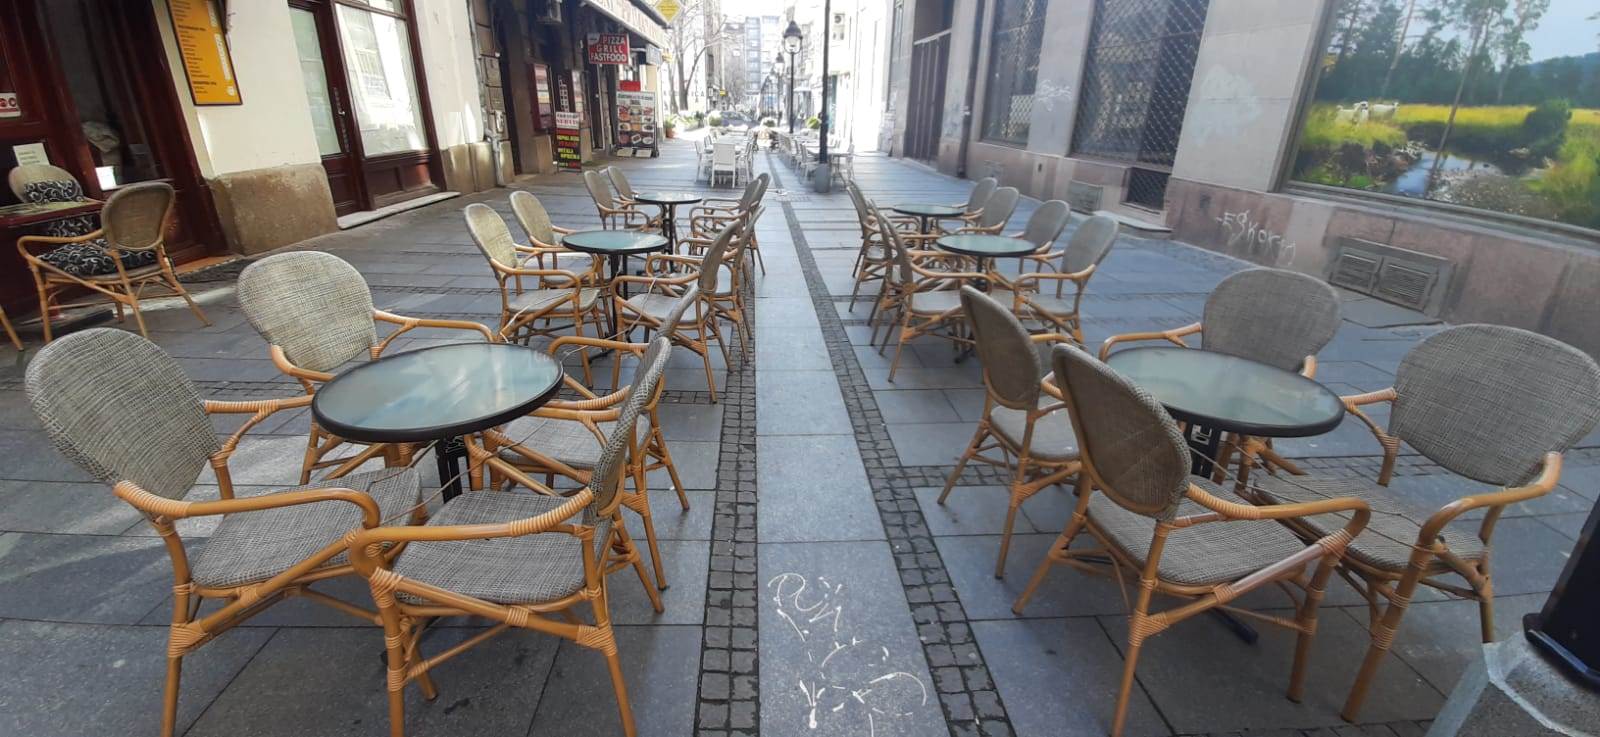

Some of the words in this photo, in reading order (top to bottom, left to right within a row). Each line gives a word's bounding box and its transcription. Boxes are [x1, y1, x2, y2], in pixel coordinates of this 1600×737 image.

[602, 35, 625, 45] PIZZA
[596, 44, 624, 54] GRILL
[590, 52, 627, 62] FASTFOOD
